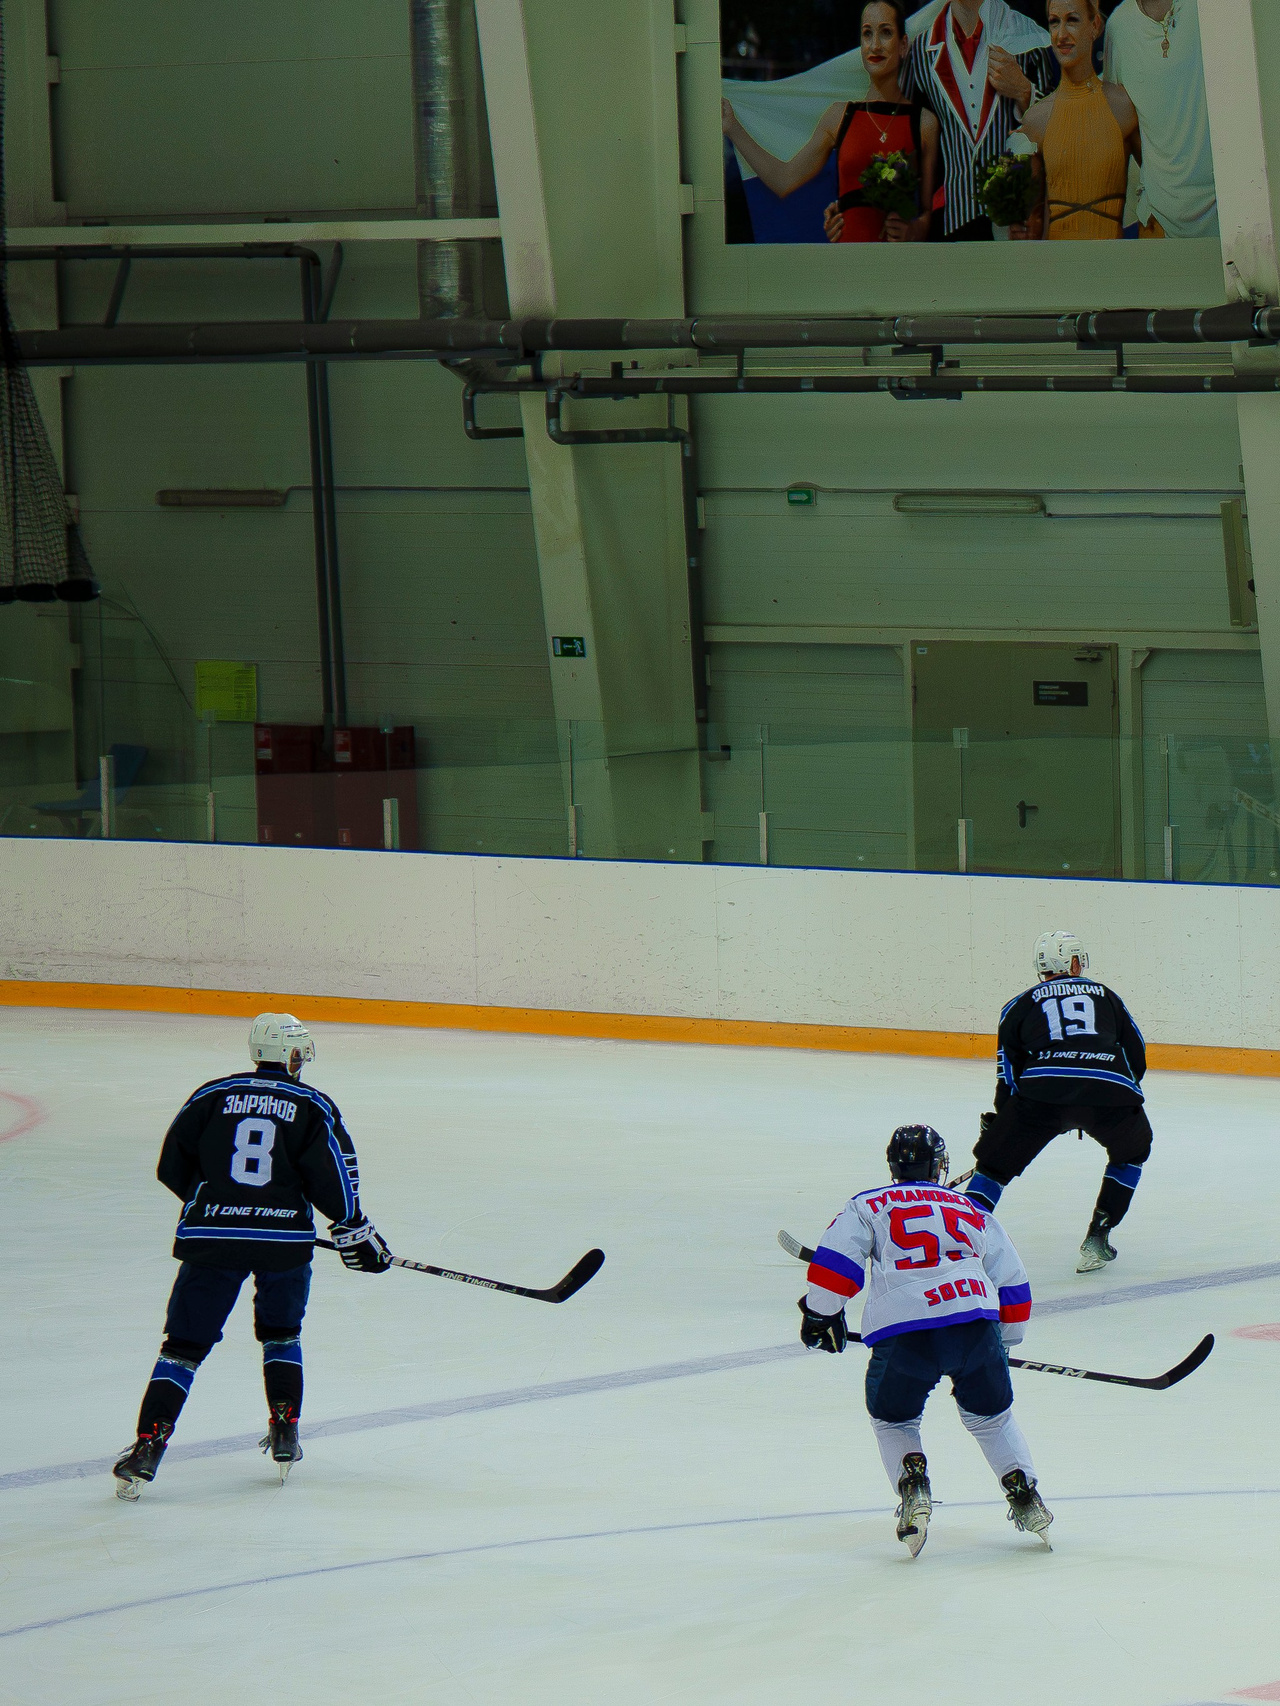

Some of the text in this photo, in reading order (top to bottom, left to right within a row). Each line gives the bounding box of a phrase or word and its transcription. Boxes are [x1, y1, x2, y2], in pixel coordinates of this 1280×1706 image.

[1041, 995, 1099, 1041] 19
[1052, 1051, 1116, 1062] ONE TIMER
[222, 1094, 298, 1122] ЗЫРЯНОВ
[230, 1117, 277, 1187] 8
[220, 1206, 298, 1218] ONE TIMER
[887, 1204, 986, 1270] 55
[440, 1270, 498, 1289] ONE TIMER
[924, 1279, 987, 1307] SOCHI
[1020, 1361, 1087, 1378] CCM
